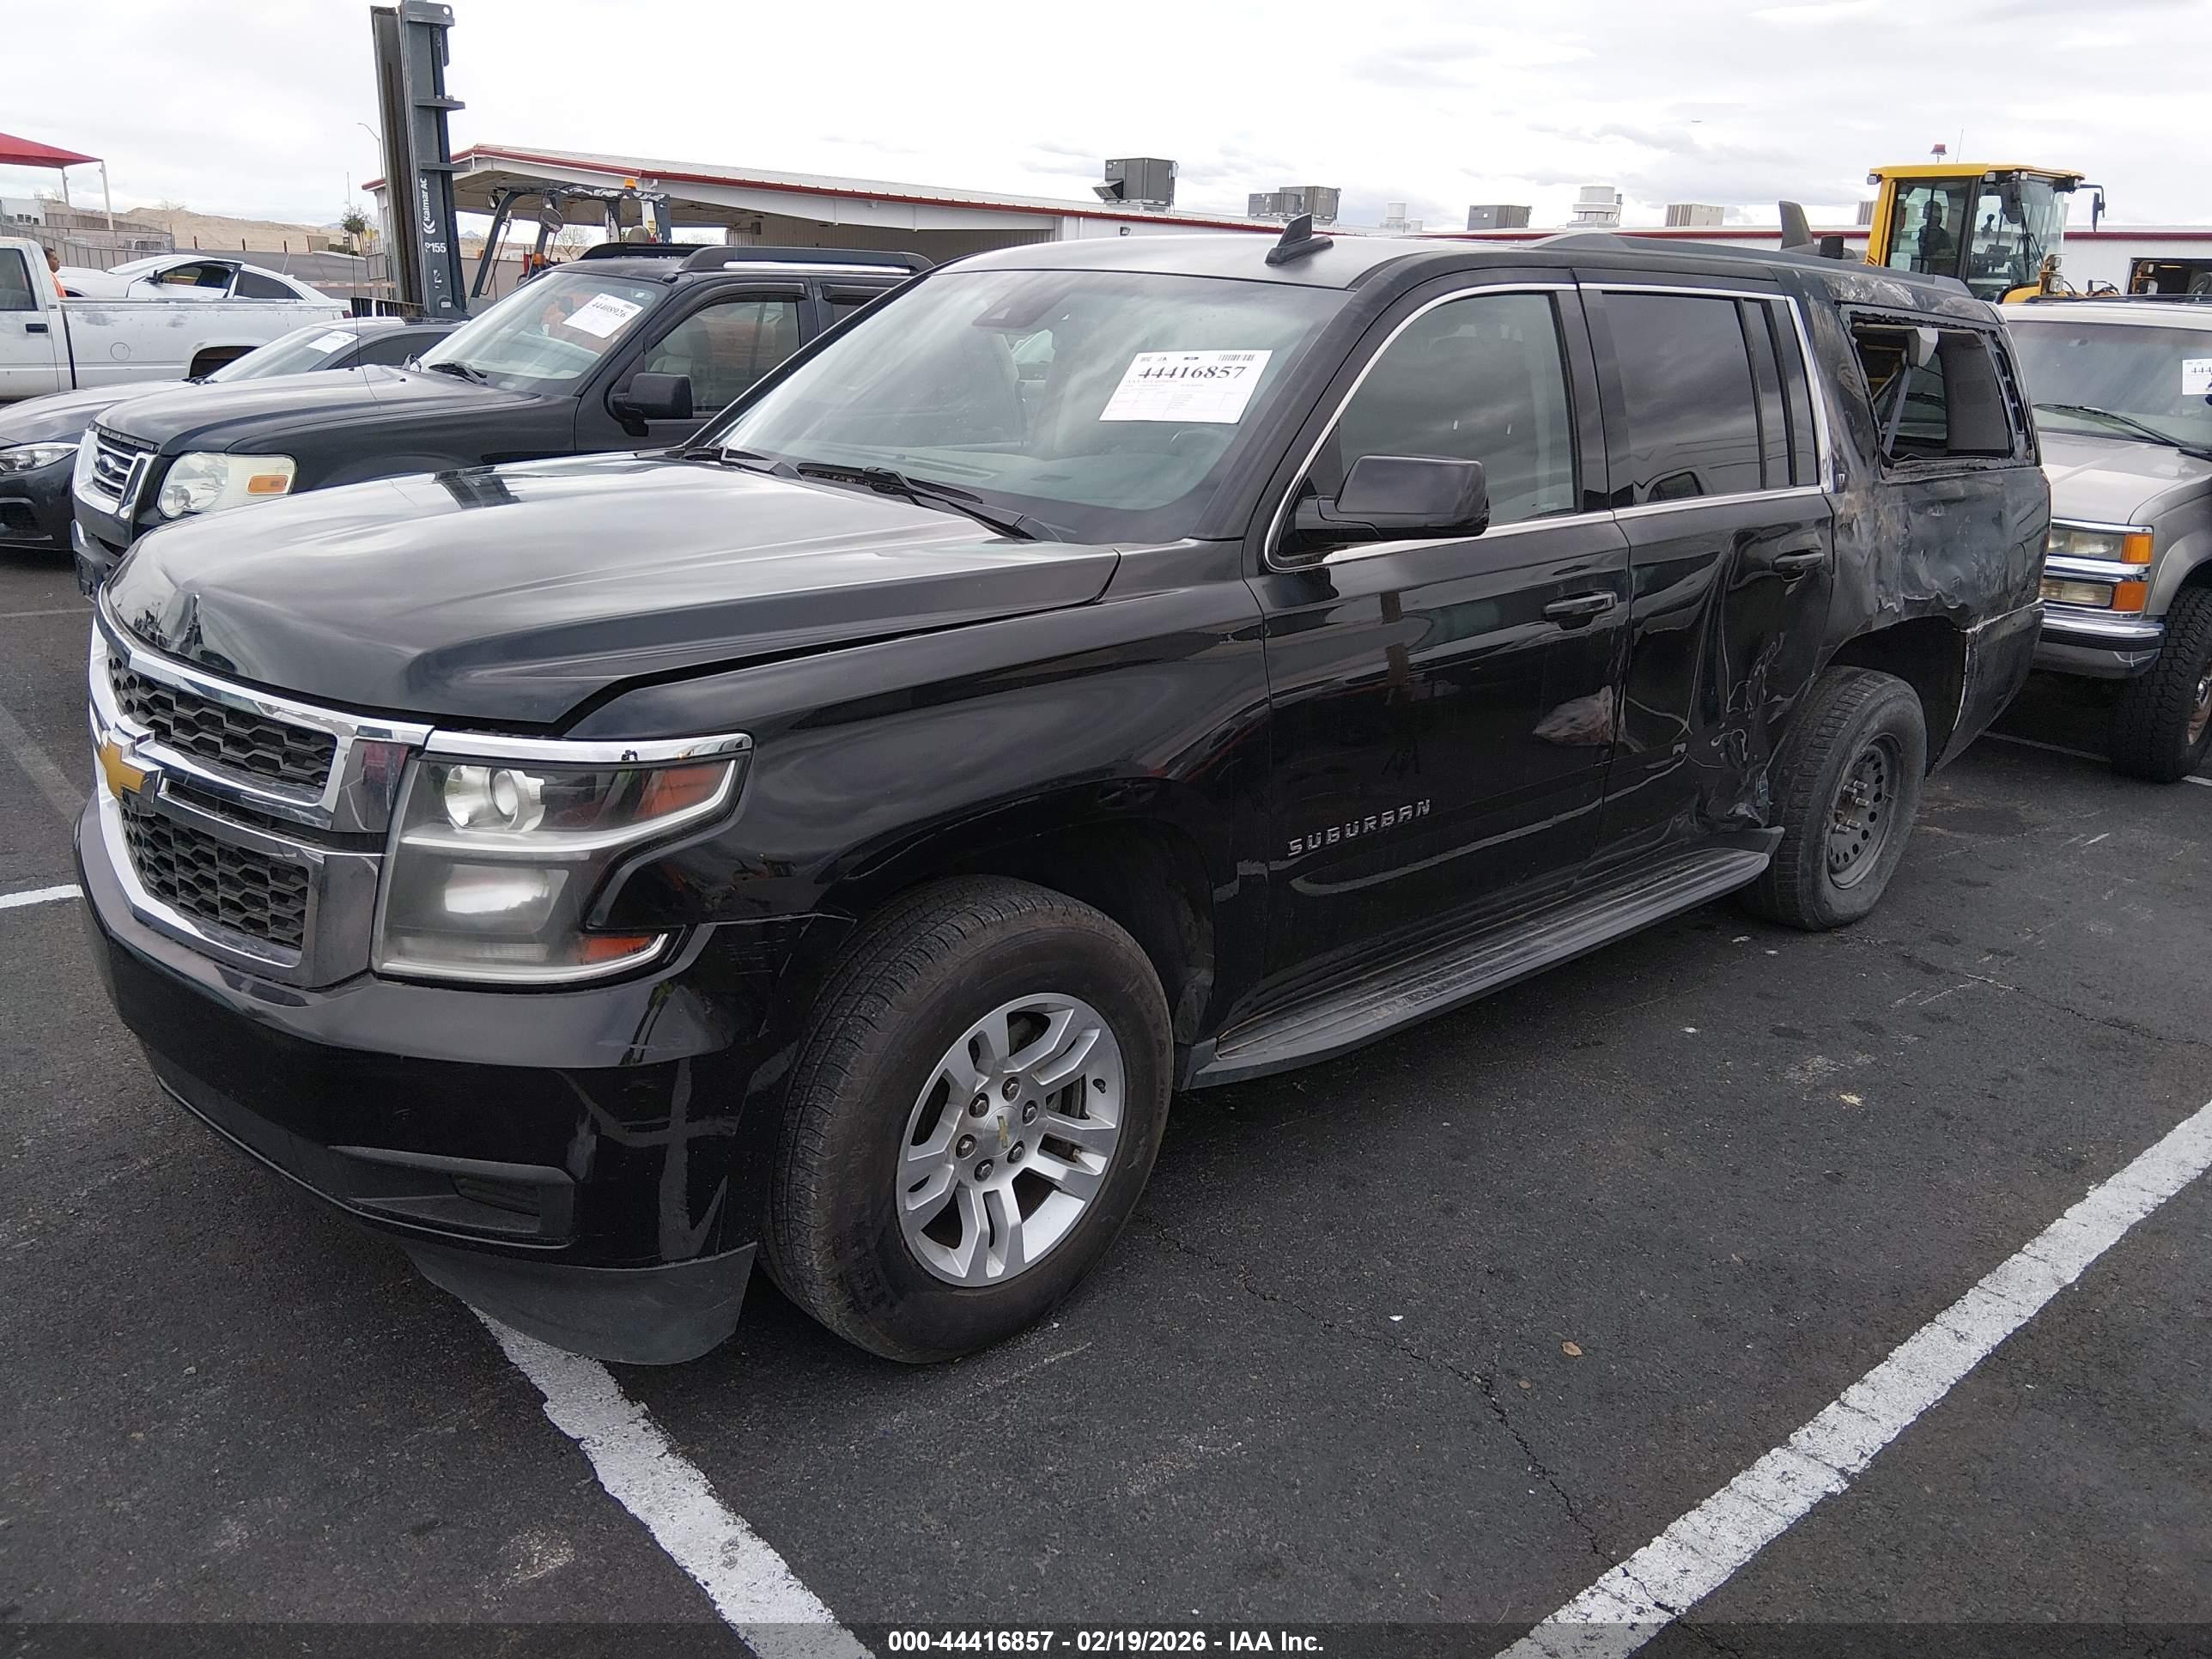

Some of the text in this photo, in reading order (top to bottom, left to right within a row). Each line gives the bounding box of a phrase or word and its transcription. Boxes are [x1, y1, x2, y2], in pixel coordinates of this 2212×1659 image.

[419, 177, 431, 222] Kalmar AC
[1138, 365, 1248, 379] 44416857
[1288, 799, 1431, 857] SUBURBAN
